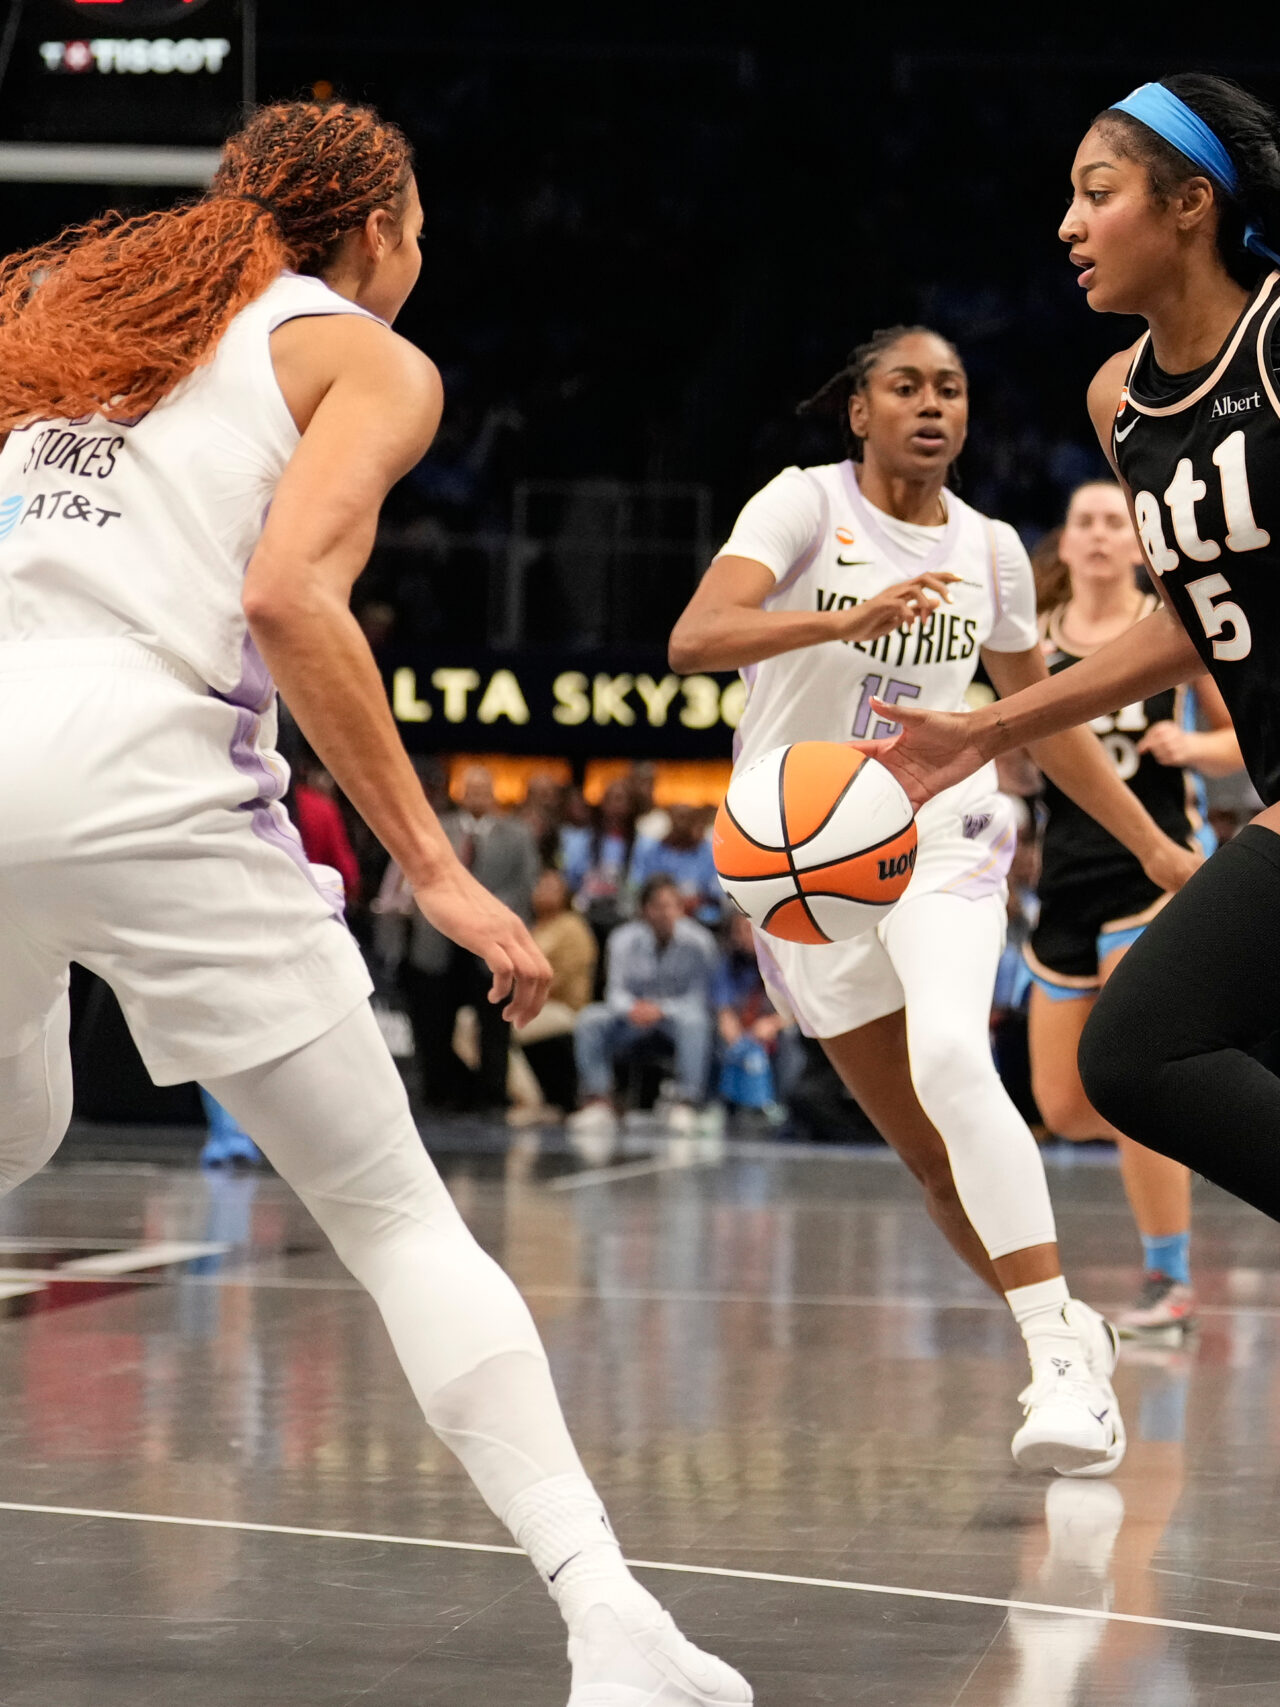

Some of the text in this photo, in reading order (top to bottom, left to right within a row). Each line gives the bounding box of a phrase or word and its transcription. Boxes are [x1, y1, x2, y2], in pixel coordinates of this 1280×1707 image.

[90, 37, 230, 75] TISSOT
[1211, 391, 1261, 418] Albert
[23, 428, 125, 479] STOKES
[20, 490, 122, 528] AT&T
[1184, 572, 1252, 662] 5
[392, 666, 531, 726] LTA
[851, 672, 921, 741] 15
